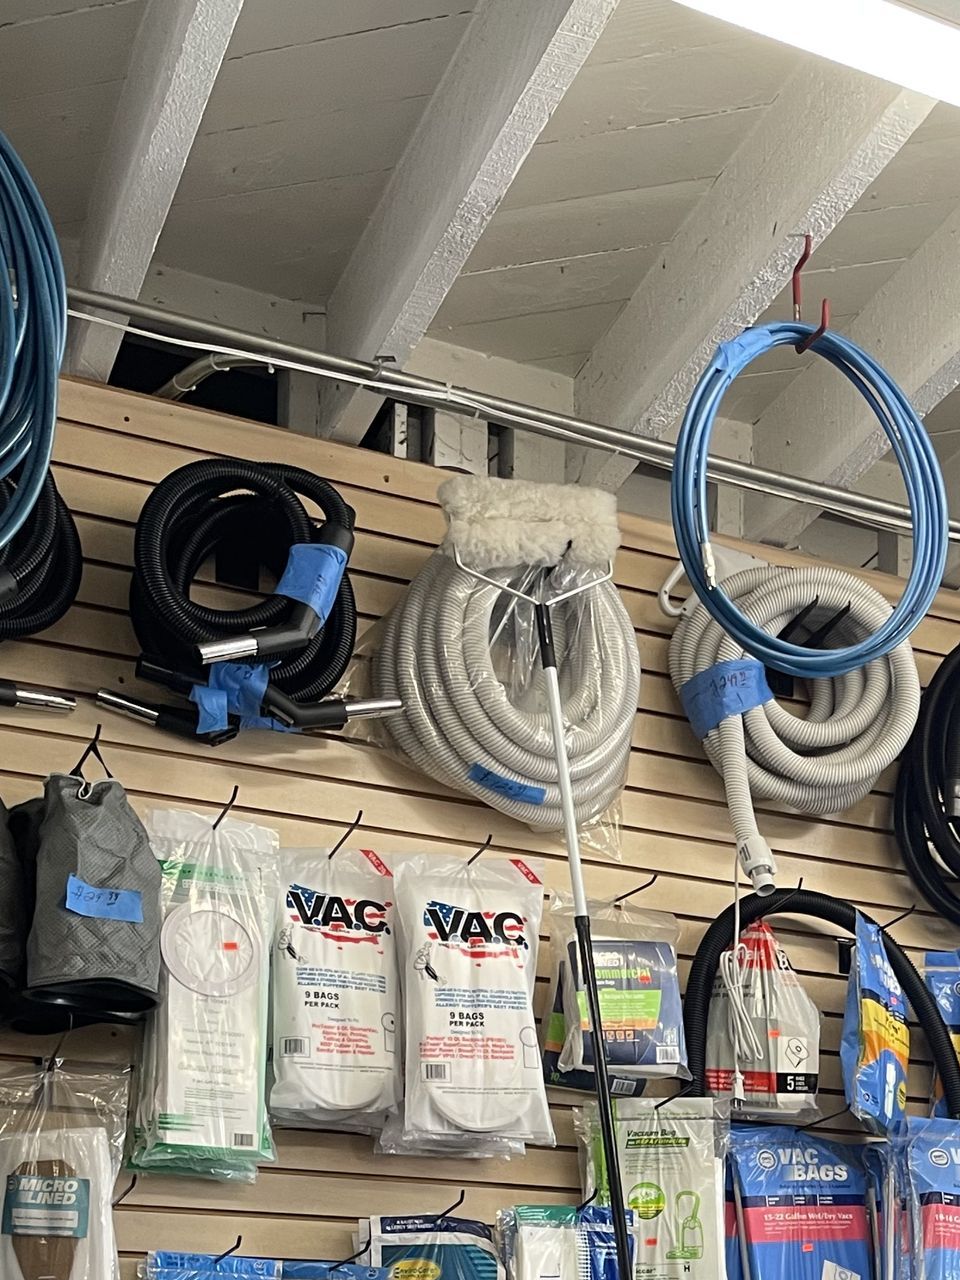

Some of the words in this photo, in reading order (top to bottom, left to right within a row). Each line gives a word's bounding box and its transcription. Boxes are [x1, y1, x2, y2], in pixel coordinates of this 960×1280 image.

[305, 991, 311, 999] 9
[314, 991, 340, 1001] BAGS
[304, 1000, 319, 1008] PER
[321, 1001, 340, 1009] PACK
[450, 1012, 456, 1020] 9
[458, 1012, 485, 1021] BAGS
[787, 1076, 794, 1090] 5
[626, 1130, 658, 1138] Vacuum
[660, 1130, 676, 1138] Bag
[780, 1150, 818, 1164] VAC
[792, 1164, 848, 1182] BAGS
[19, 1179, 78, 1191] MICRO
[25, 1192, 76, 1205] LINED
[684, 1264, 690, 1272] H
